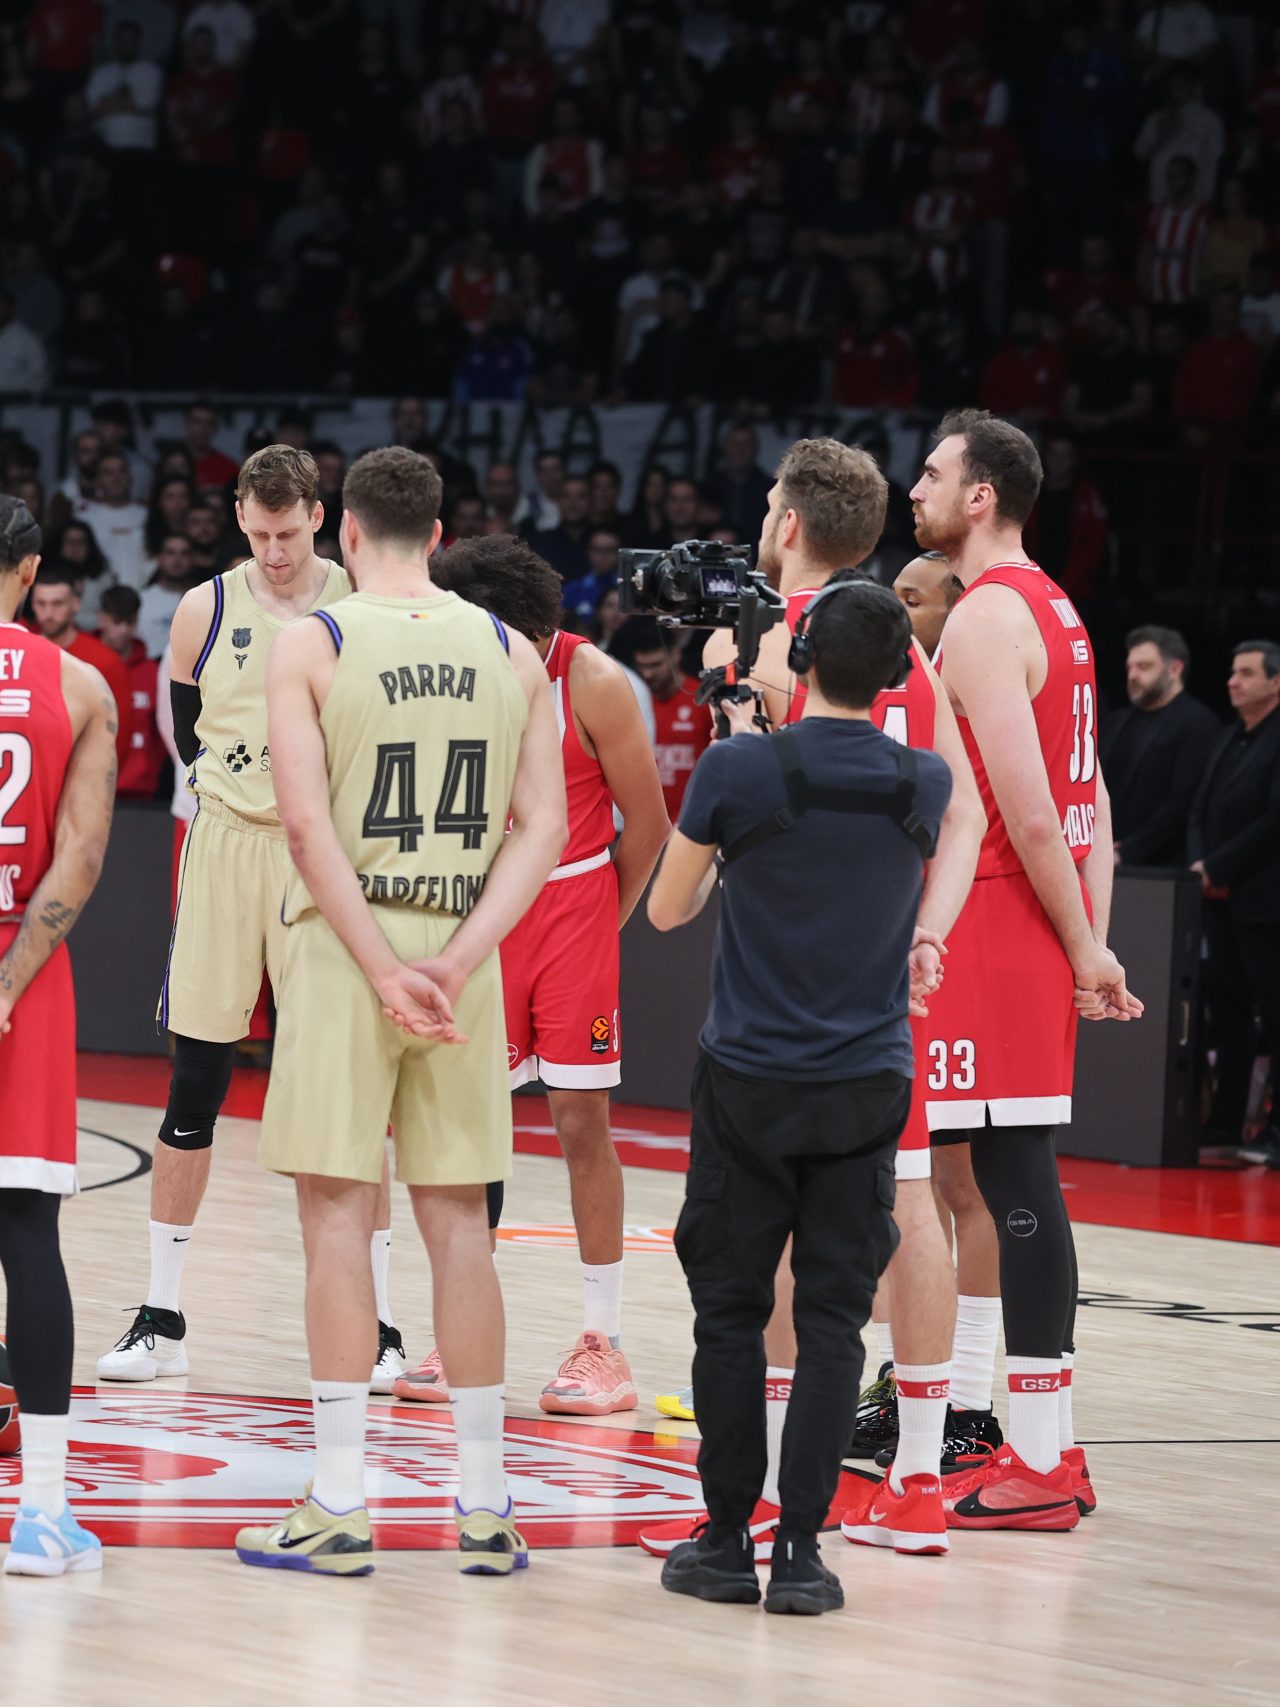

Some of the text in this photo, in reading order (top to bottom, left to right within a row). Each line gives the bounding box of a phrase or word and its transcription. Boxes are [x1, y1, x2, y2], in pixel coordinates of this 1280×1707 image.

[379, 664, 476, 705] PARRA
[1068, 683, 1096, 784] 33
[362, 740, 488, 853] 44
[356, 872, 488, 919] ARCELON
[928, 1038, 976, 1091] 33
[1021, 1378, 1060, 1391] GSA
